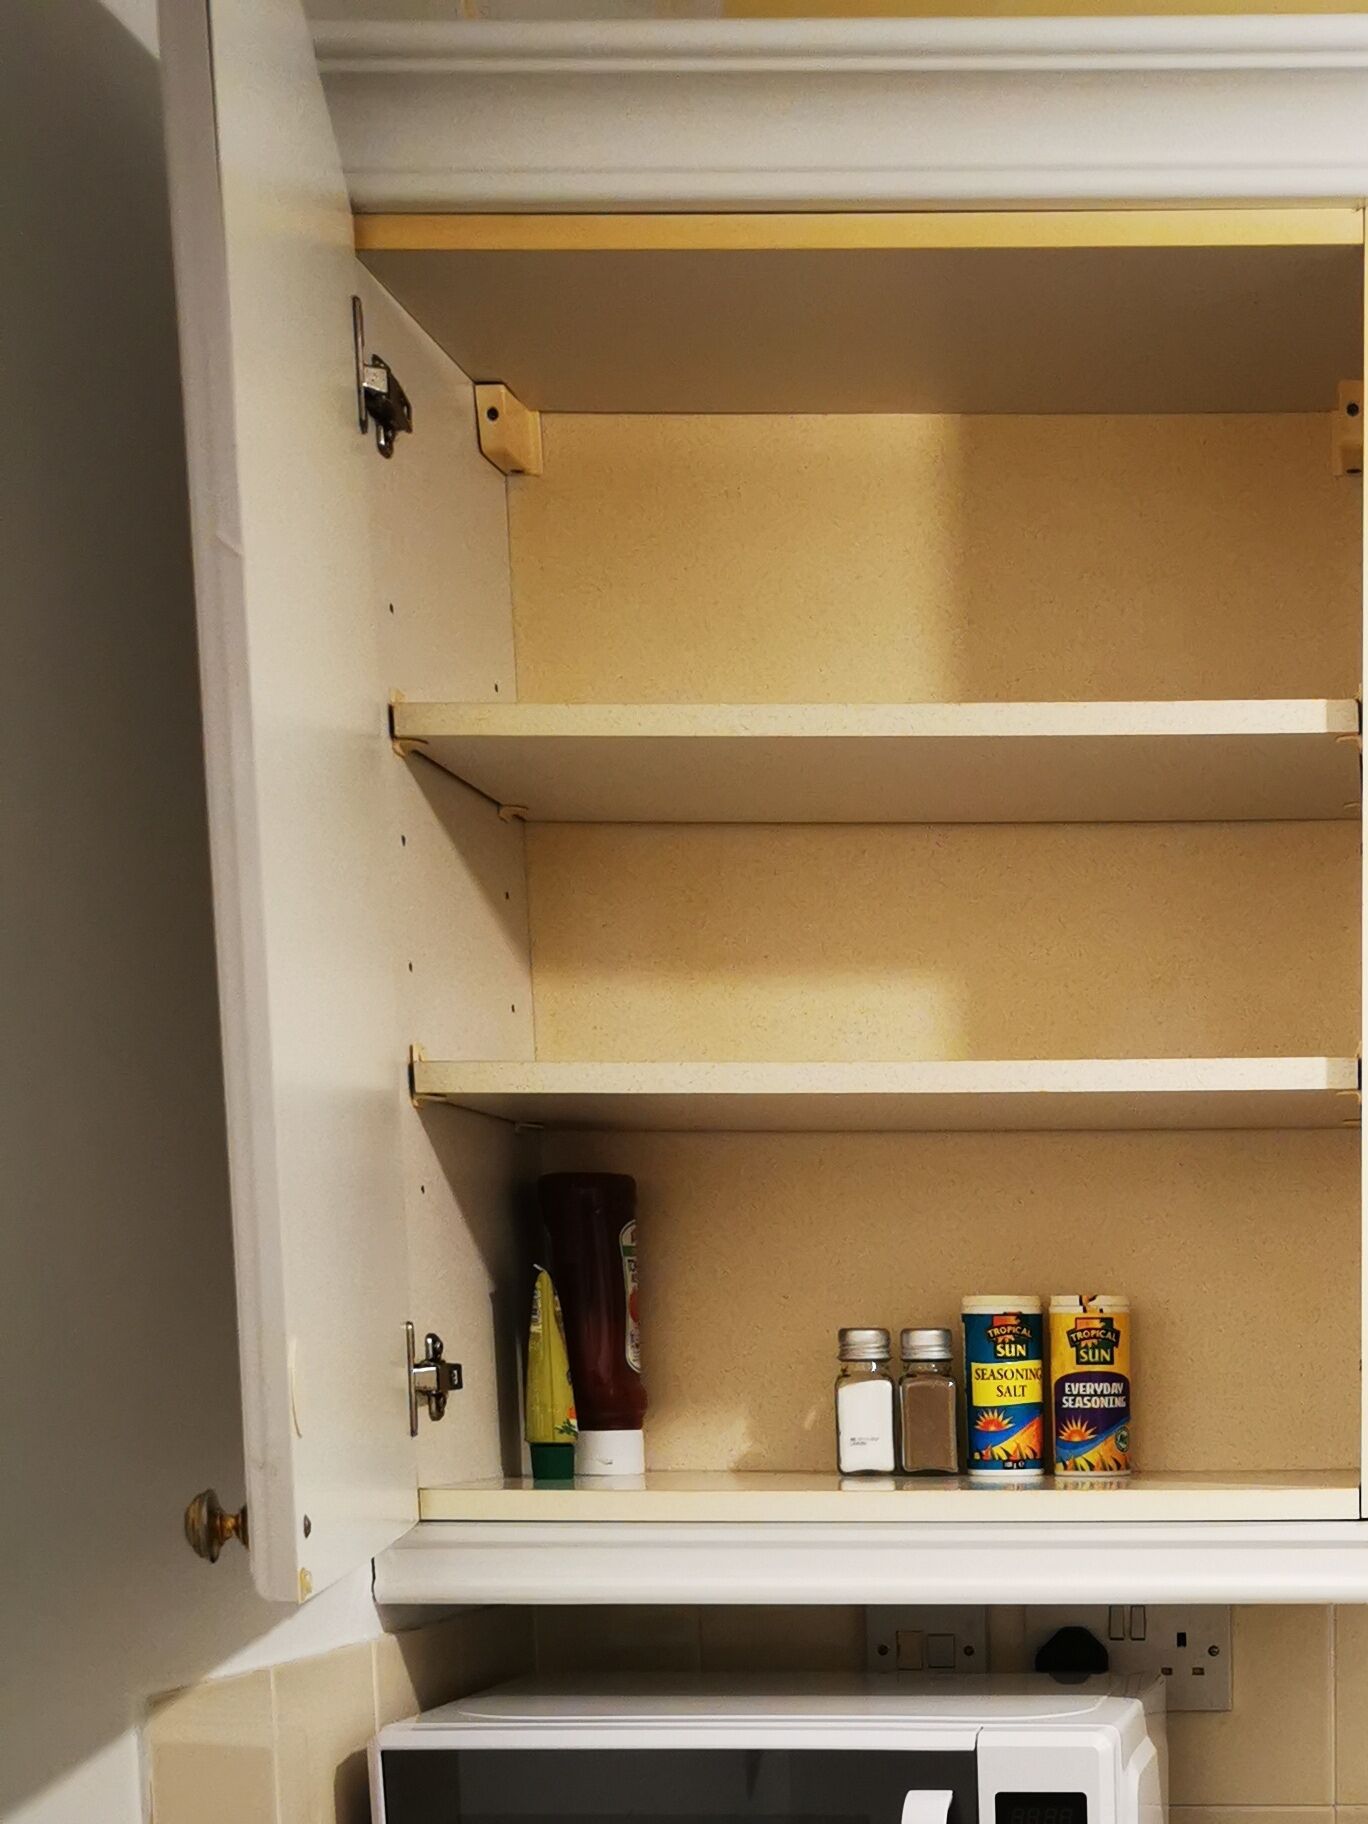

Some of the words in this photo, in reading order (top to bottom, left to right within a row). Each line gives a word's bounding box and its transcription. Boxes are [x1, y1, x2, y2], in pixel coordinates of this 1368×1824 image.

[987, 1326, 1032, 1338] TROPICAL
[1070, 1329, 1116, 1342] TROPICAL
[996, 1343, 1027, 1357] SUN
[1079, 1348, 1111, 1362] SUN
[974, 1367, 1042, 1381] SEASONING
[996, 1384, 1027, 1397] SALT
[1064, 1382, 1124, 1395] EVERYDAY
[1061, 1396, 1127, 1409] SEASONING
